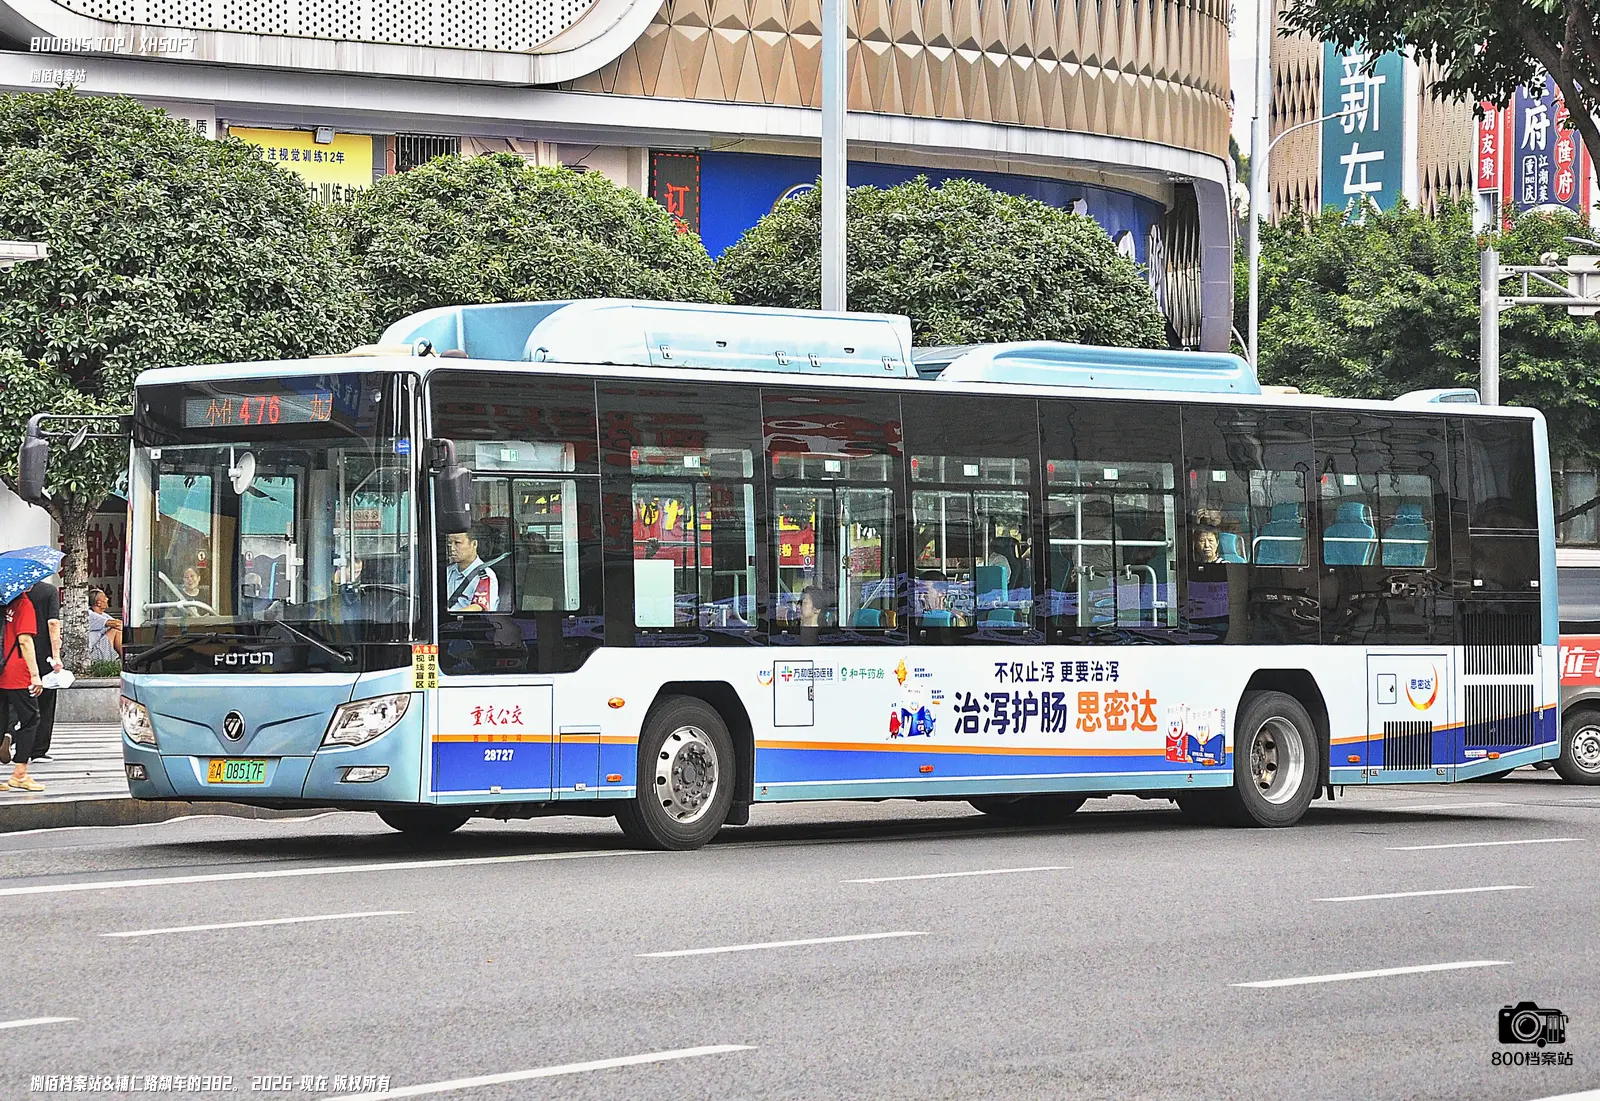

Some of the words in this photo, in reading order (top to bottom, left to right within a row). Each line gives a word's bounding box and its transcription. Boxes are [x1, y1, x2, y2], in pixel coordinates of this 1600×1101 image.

[1480, 110, 1496, 181] 朋友聚
[1538, 154, 1549, 202] 江湖菜
[238, 395, 280, 425] 476
[213, 651, 275, 667] FOTON
[849, 668, 885, 680] 和平药房
[994, 661, 1055, 683] 不仅止泻
[1060, 660, 1120, 682] 更要治泻
[470, 705, 524, 726] 重庆公交
[953, 690, 1067, 734] 治泻护肠
[1075, 689, 1158, 733] 思密达
[484, 748, 515, 762] 28727
